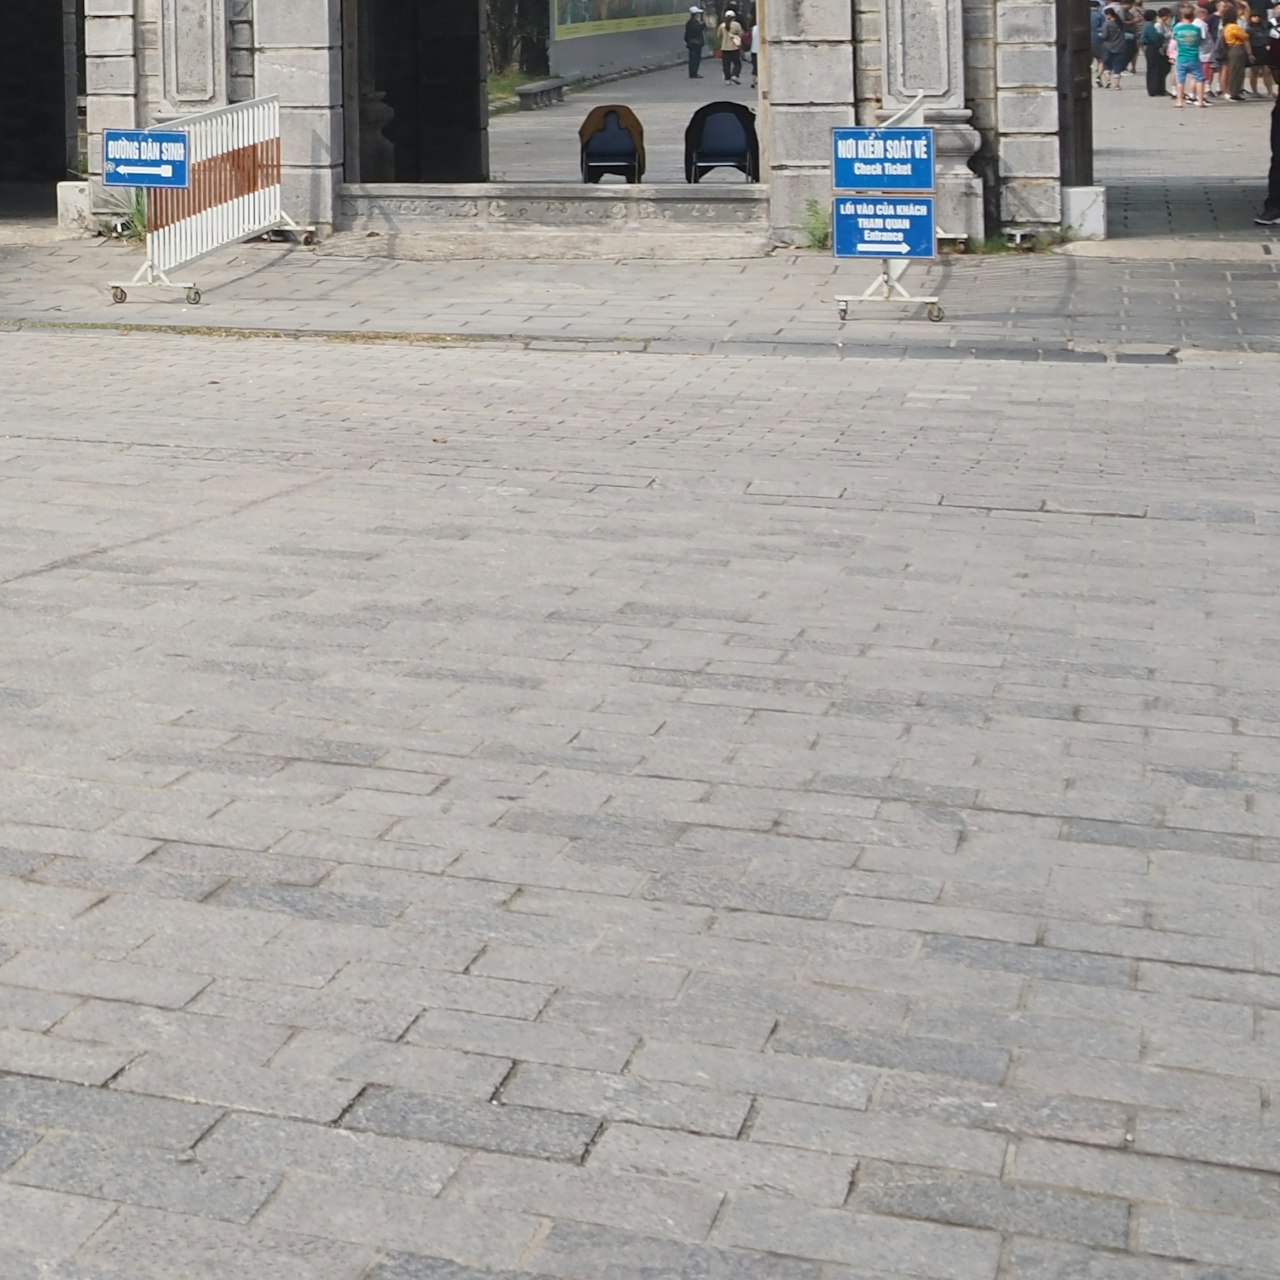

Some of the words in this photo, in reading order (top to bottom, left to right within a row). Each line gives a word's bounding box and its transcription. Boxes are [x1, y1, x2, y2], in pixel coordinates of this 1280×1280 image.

[107, 136, 139, 159] ĐƯỜNG
[161, 142, 185, 161] SINH
[858, 132, 884, 158] KIỂM
[886, 136, 912, 159] SOÁT
[913, 136, 928, 159] VÉ
[854, 162, 882, 175] Check
[883, 162, 912, 175] Ticket
[840, 201, 854, 215] LỐI
[856, 202, 875, 215] VÀO
[876, 201, 895, 216] CỦA
[896, 203, 928, 216] KHÁCH
[857, 218, 884, 229] THAM
[885, 218, 910, 230] QUAN
[864, 229, 904, 242] Entrance
